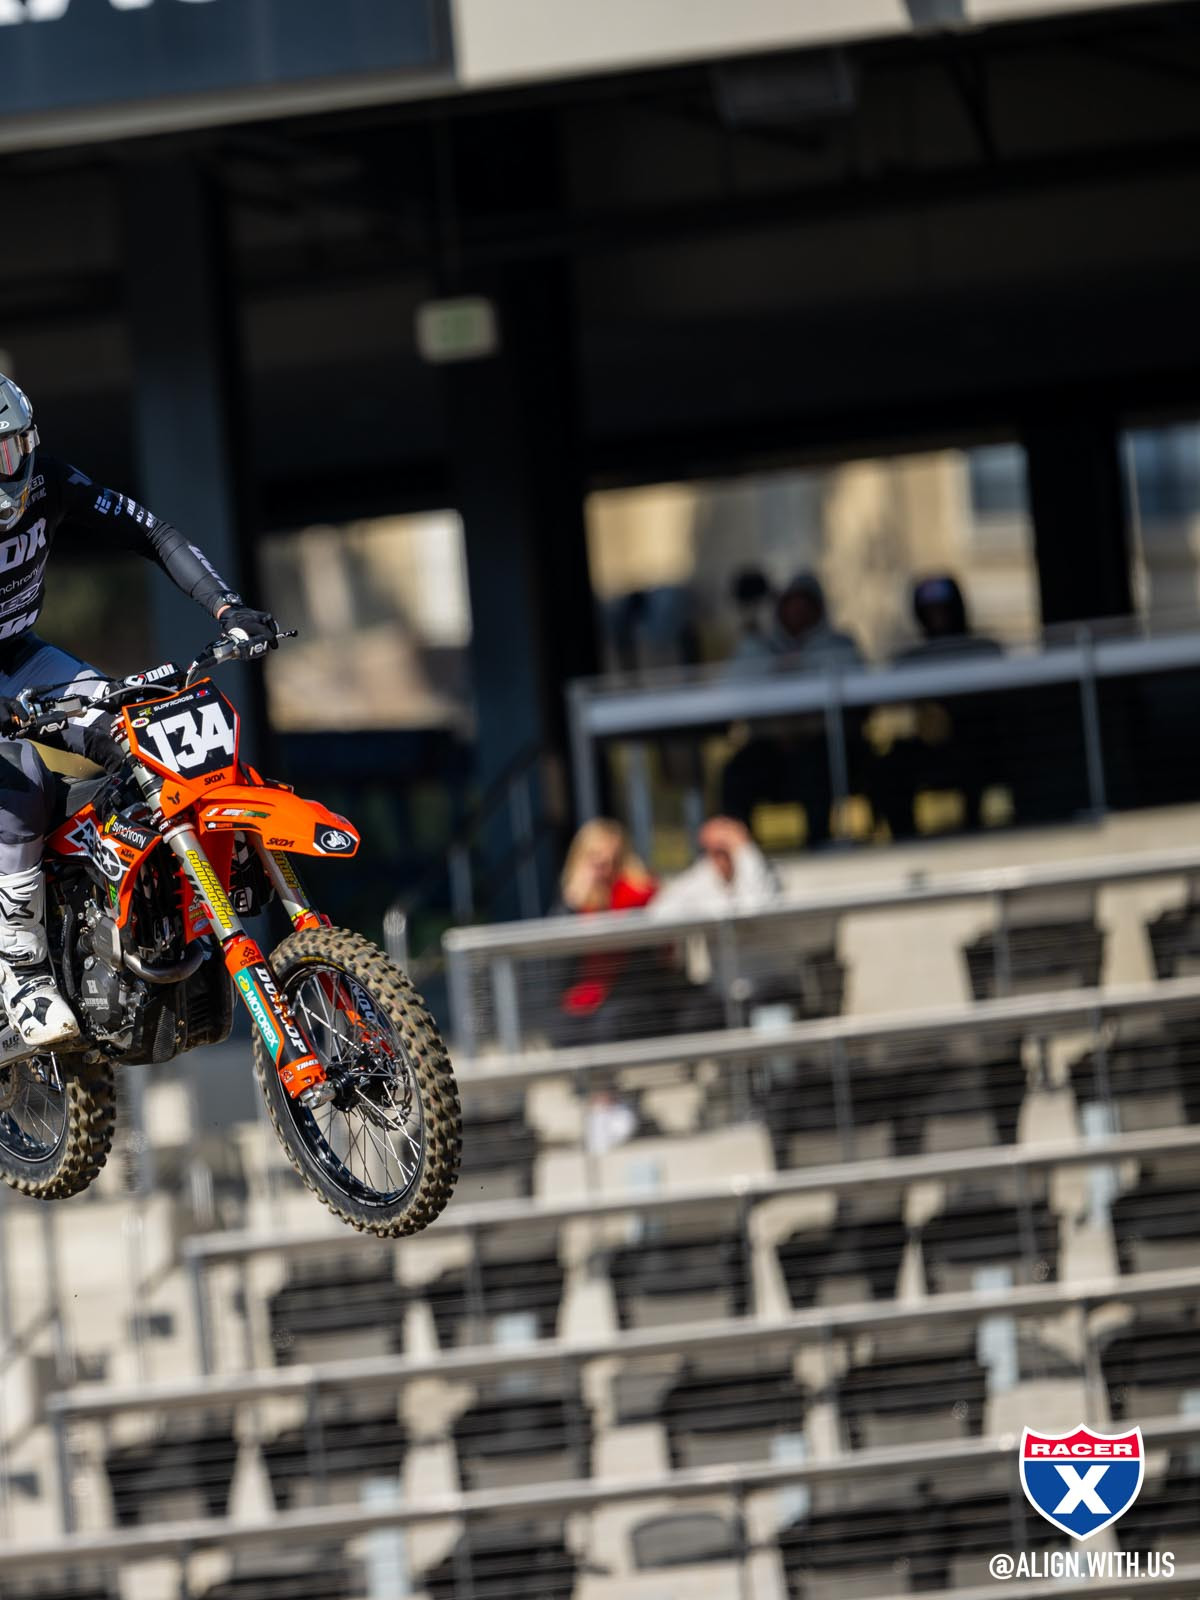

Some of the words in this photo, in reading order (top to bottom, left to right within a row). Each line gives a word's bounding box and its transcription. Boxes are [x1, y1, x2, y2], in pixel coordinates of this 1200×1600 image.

[146, 702, 235, 772] 134
[112, 821, 147, 849] synchrony
[245, 991, 279, 1048] MOTOREX
